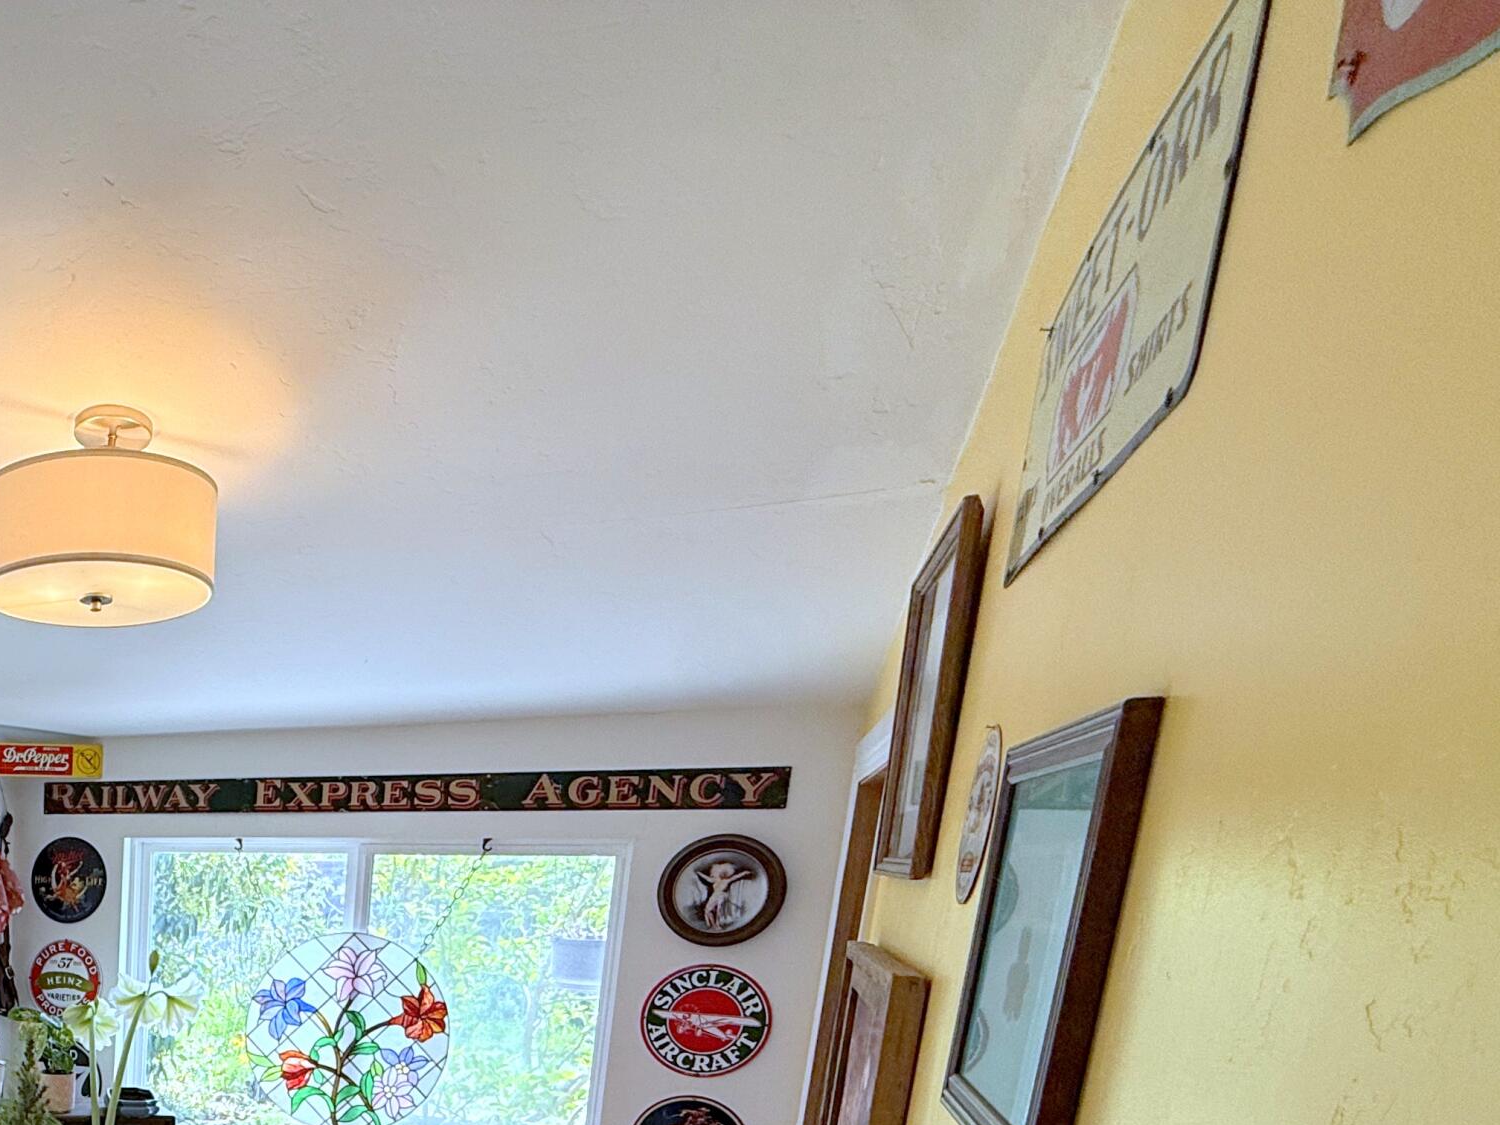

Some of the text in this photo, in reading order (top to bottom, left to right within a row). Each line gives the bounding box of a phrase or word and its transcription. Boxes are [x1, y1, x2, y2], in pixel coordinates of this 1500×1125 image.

[52, 772, 778, 812] RAILWAY EXPRESS AGENCY
[36, 942, 97, 976] PURE FOOD
[57, 957, 74, 969] 57
[46, 975, 83, 988] HEINZ
[653, 970, 763, 1017] SINCLAIR
[647, 1023, 757, 1073] AIRCRAFT
